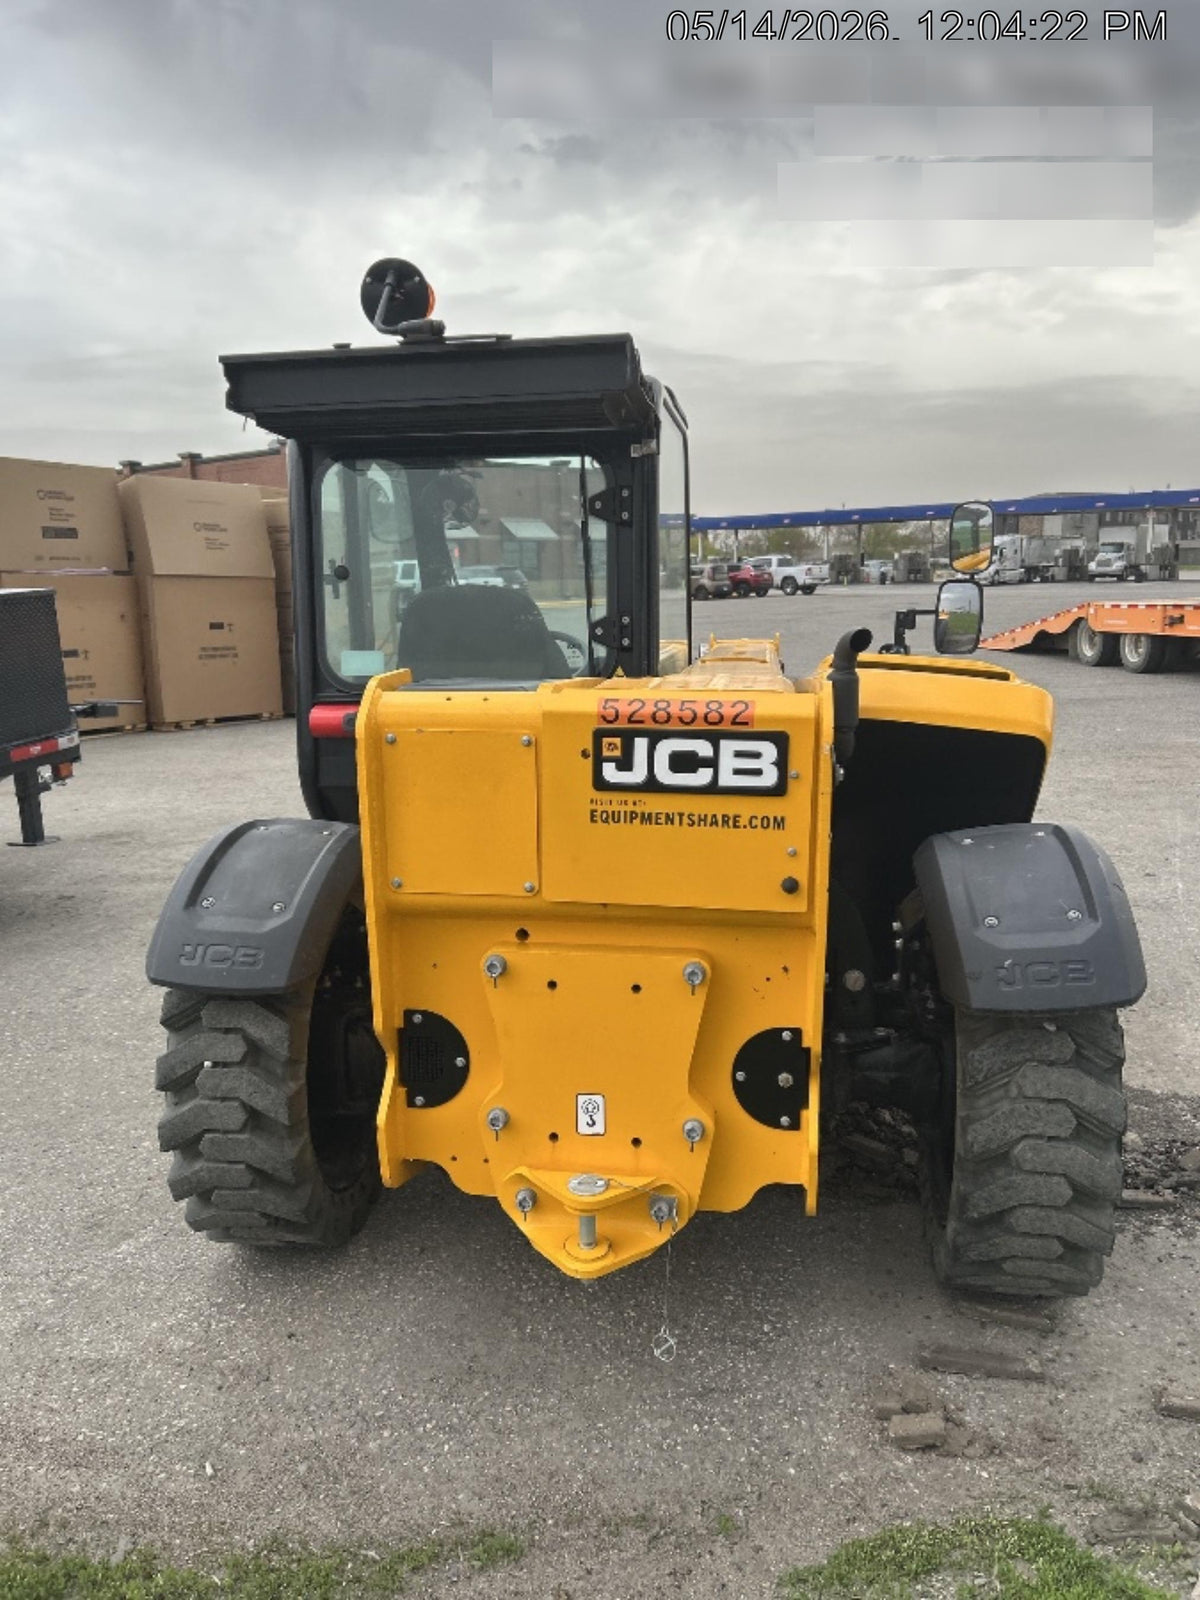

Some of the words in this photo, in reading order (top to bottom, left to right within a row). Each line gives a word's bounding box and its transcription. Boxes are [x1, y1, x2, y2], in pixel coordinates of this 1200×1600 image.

[600, 698, 750, 726] 528582
[601, 736, 779, 788] JCB
[589, 808, 786, 831] EQUIPMENTSHARE.COM
[179, 943, 264, 970] JCB
[995, 959, 1097, 991] JCB
